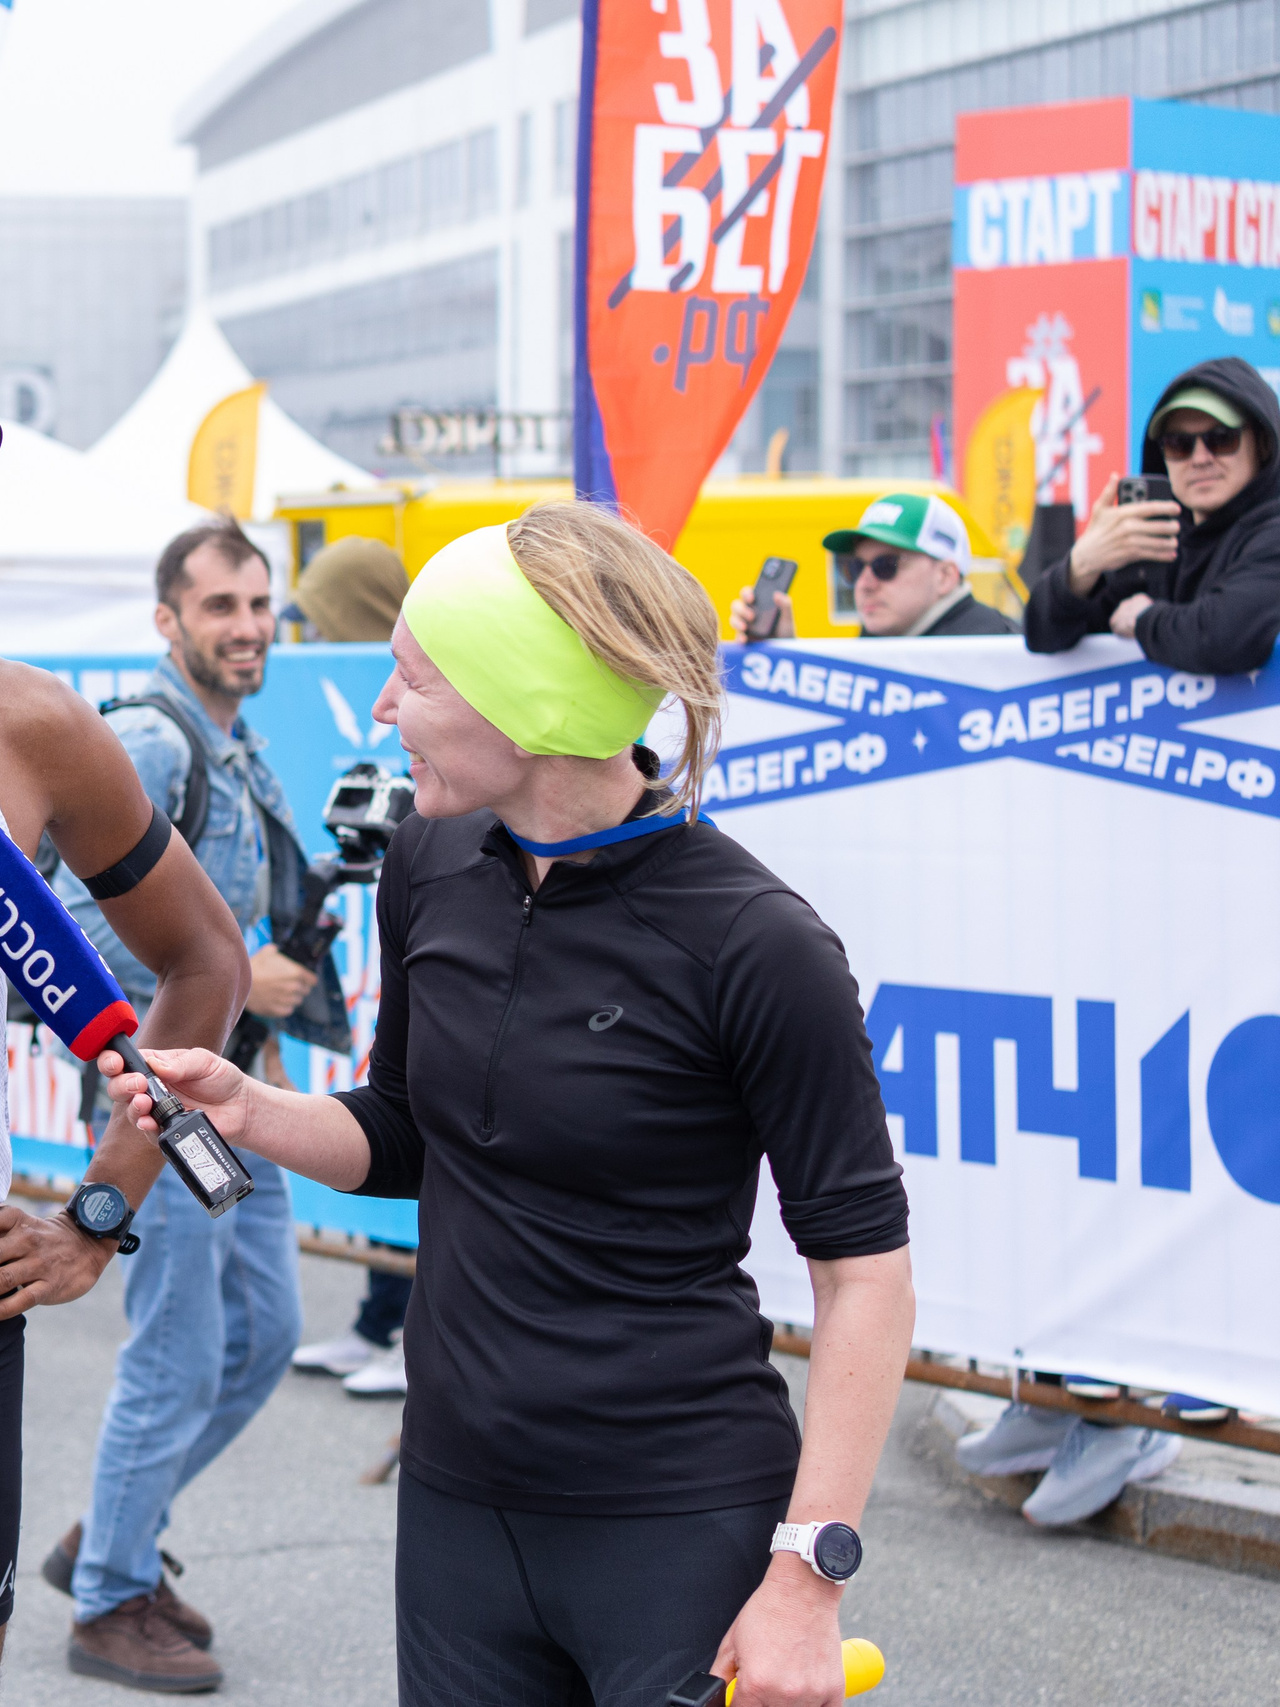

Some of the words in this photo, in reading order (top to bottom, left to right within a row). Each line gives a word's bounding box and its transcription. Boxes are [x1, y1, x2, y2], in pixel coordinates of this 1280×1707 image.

[651, 0, 810, 128] ЗА
[628, 123, 824, 294] БЕГ
[968, 171, 1121, 271] СТАРТ
[1134, 170, 1233, 265] СТАРТ
[958, 670, 1216, 753] ЗАБЕГ.РФ
[700, 732, 887, 805] АБЕГ.РФ
[1055, 732, 1276, 800] БЕГ.РФ
[181, 1137, 226, 1191] 372
